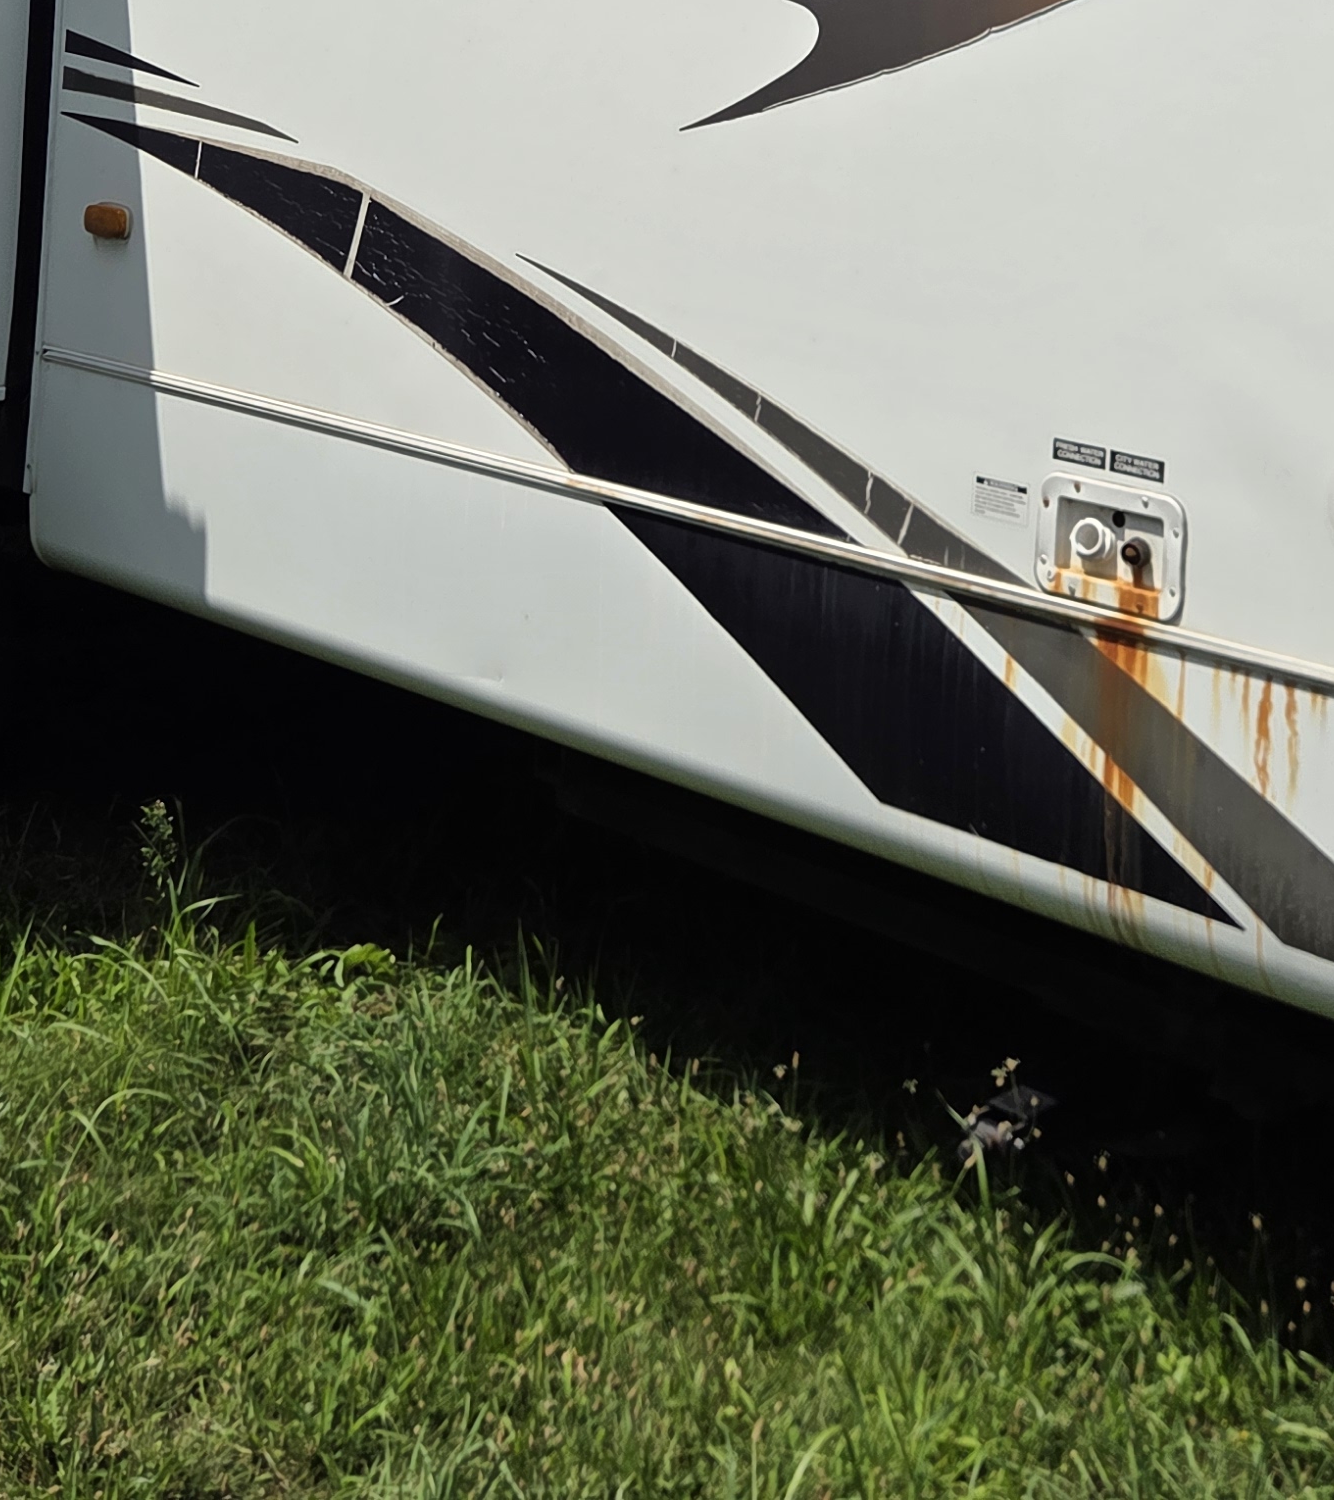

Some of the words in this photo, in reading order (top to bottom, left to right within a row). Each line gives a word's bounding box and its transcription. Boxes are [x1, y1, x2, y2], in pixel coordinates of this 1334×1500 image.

[1057, 449, 1102, 466] CONNECTION
[1080, 447, 1104, 458] WATER
[1113, 461, 1160, 479] CONNECTION
[1115, 454, 1133, 464] CITY
[1133, 457, 1160, 470] WATER
